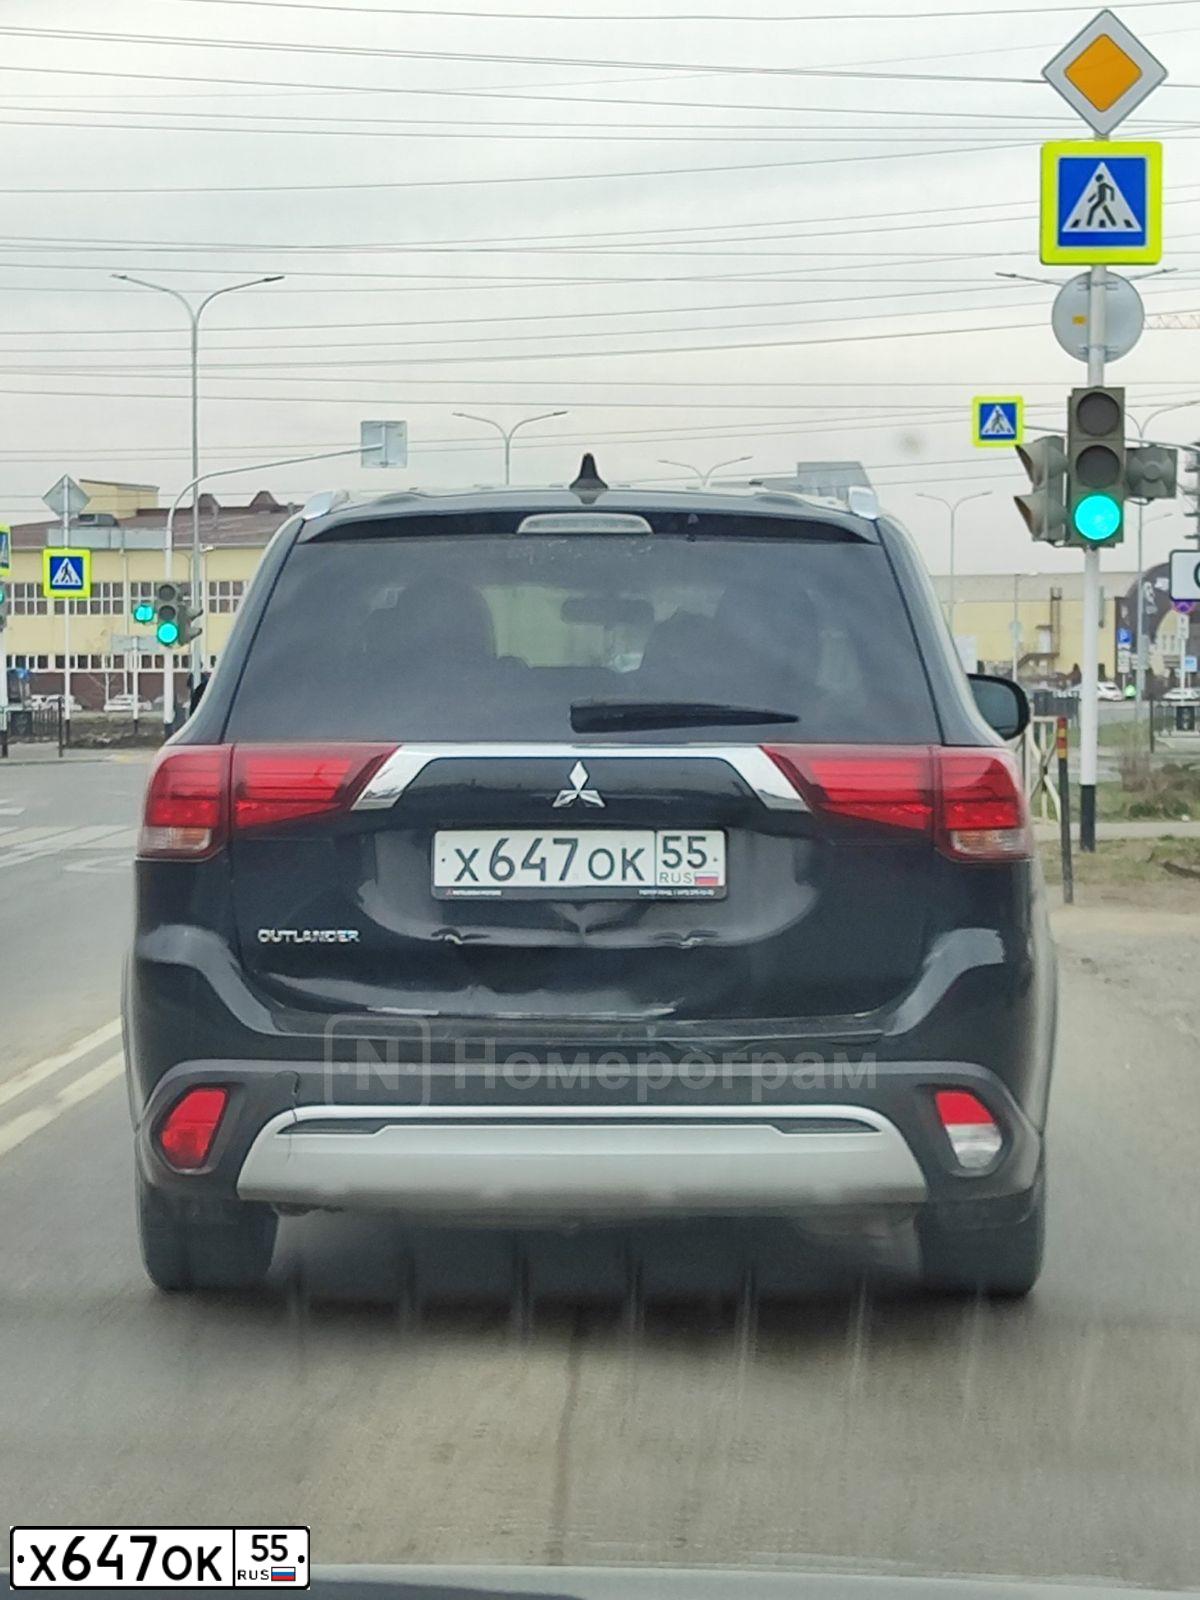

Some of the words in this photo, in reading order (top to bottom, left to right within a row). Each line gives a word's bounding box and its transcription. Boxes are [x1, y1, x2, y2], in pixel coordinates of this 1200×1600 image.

[454, 838, 645, 882] Х647ОК
[661, 836, 707, 869] 55
[659, 872, 692, 884] RUS
[257, 929, 360, 943] OUTLANDER
